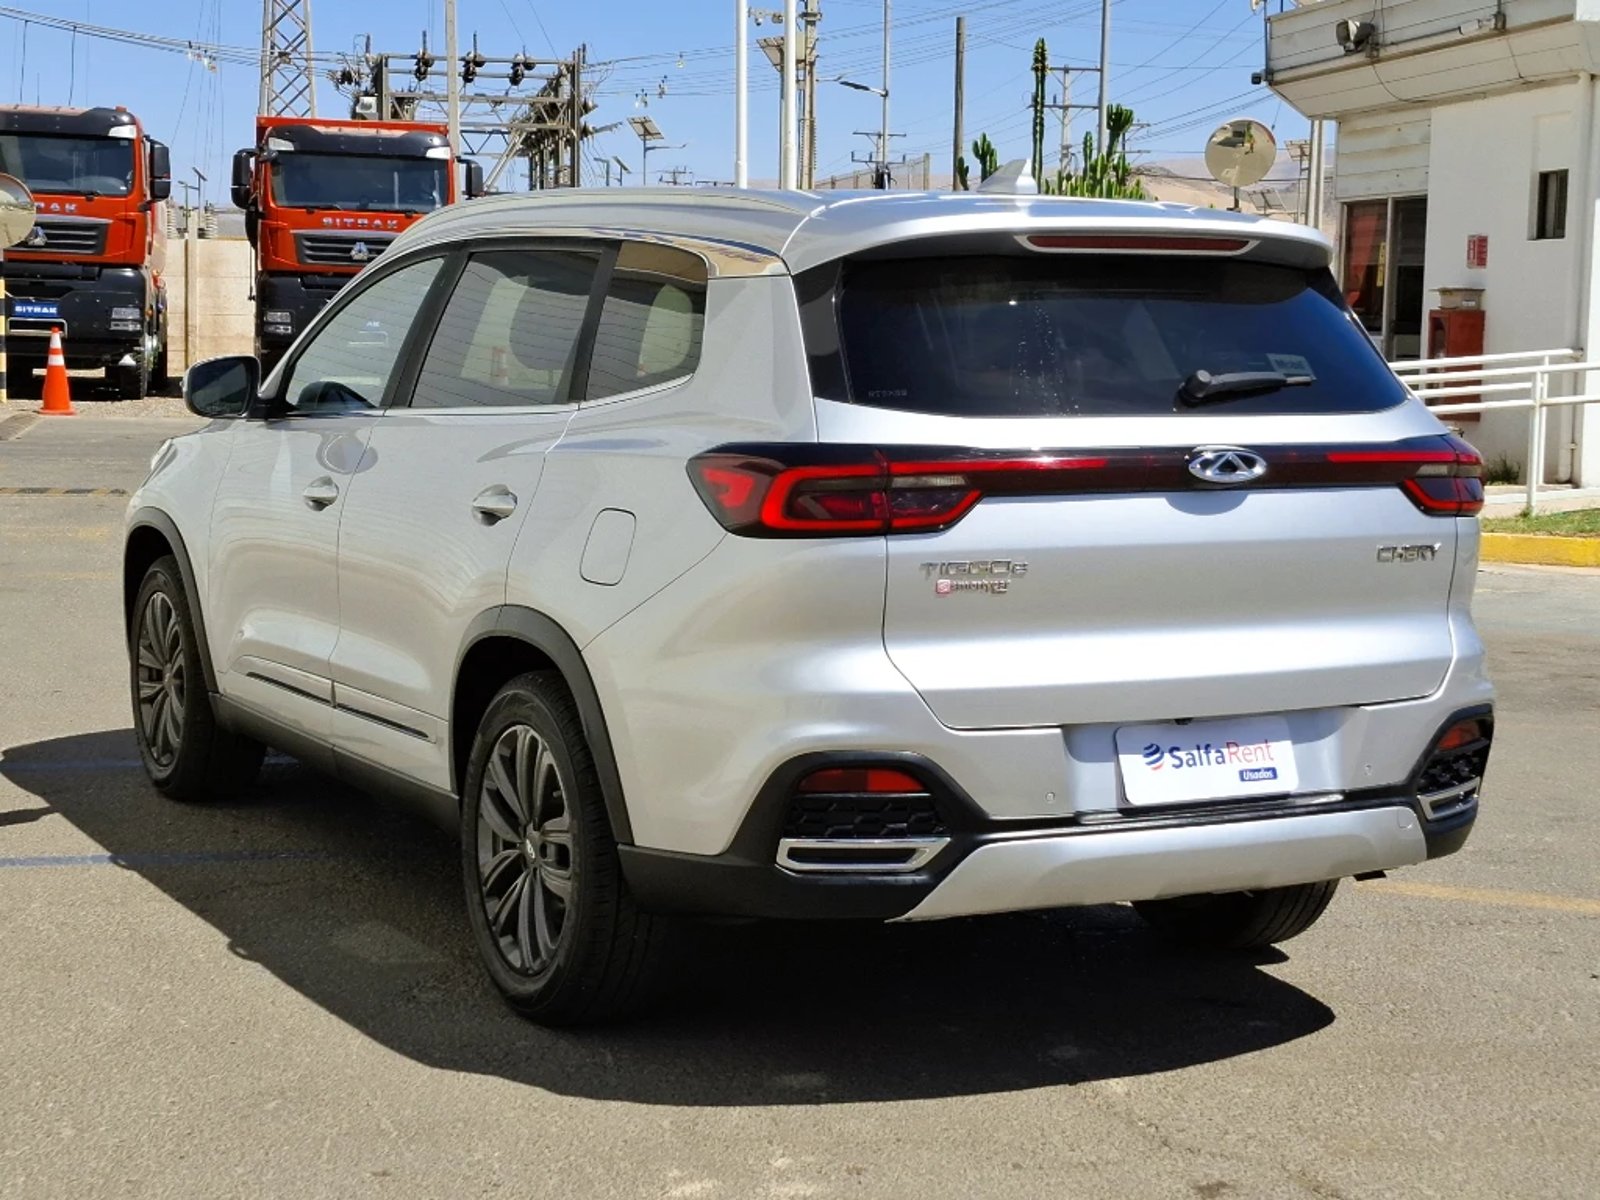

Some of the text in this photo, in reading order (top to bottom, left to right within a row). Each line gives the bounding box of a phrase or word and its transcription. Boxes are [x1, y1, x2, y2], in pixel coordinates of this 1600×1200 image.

[322, 216, 398, 229] SITRAK
[14, 305, 58, 314] SITRAK
[1168, 739, 1274, 769] SalfaRent
[1243, 769, 1273, 780] Usados
